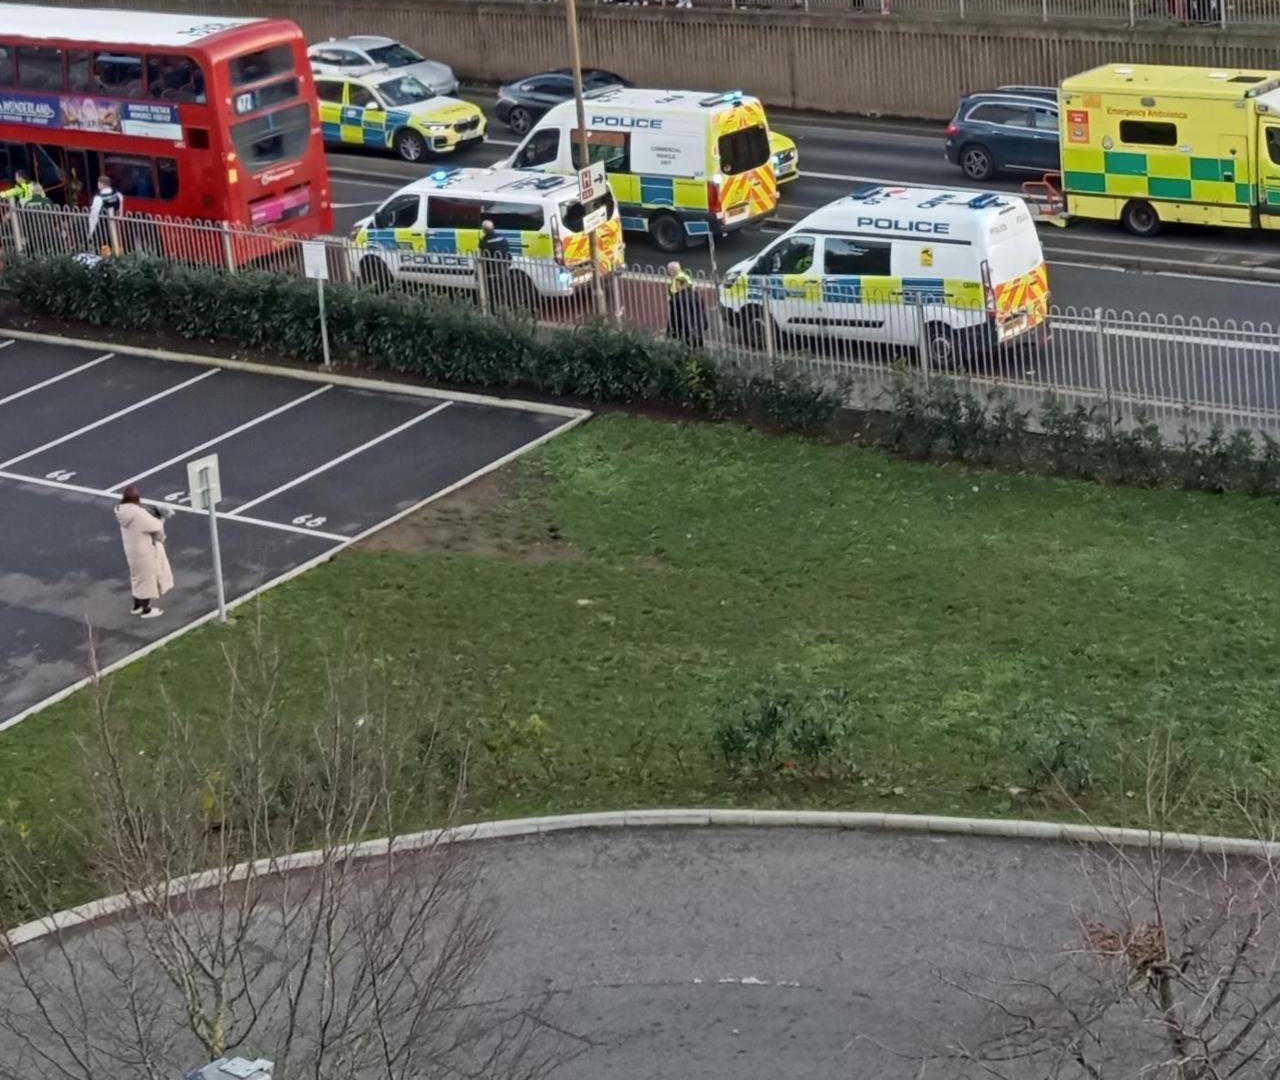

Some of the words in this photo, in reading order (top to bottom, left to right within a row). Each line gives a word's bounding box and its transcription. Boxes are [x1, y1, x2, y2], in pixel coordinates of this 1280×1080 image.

[592, 116, 663, 129] POLICE
[857, 217, 950, 234] POLICE
[400, 254, 469, 266] POLICE
[45, 469, 77, 481] 66
[292, 514, 327, 527] 68
